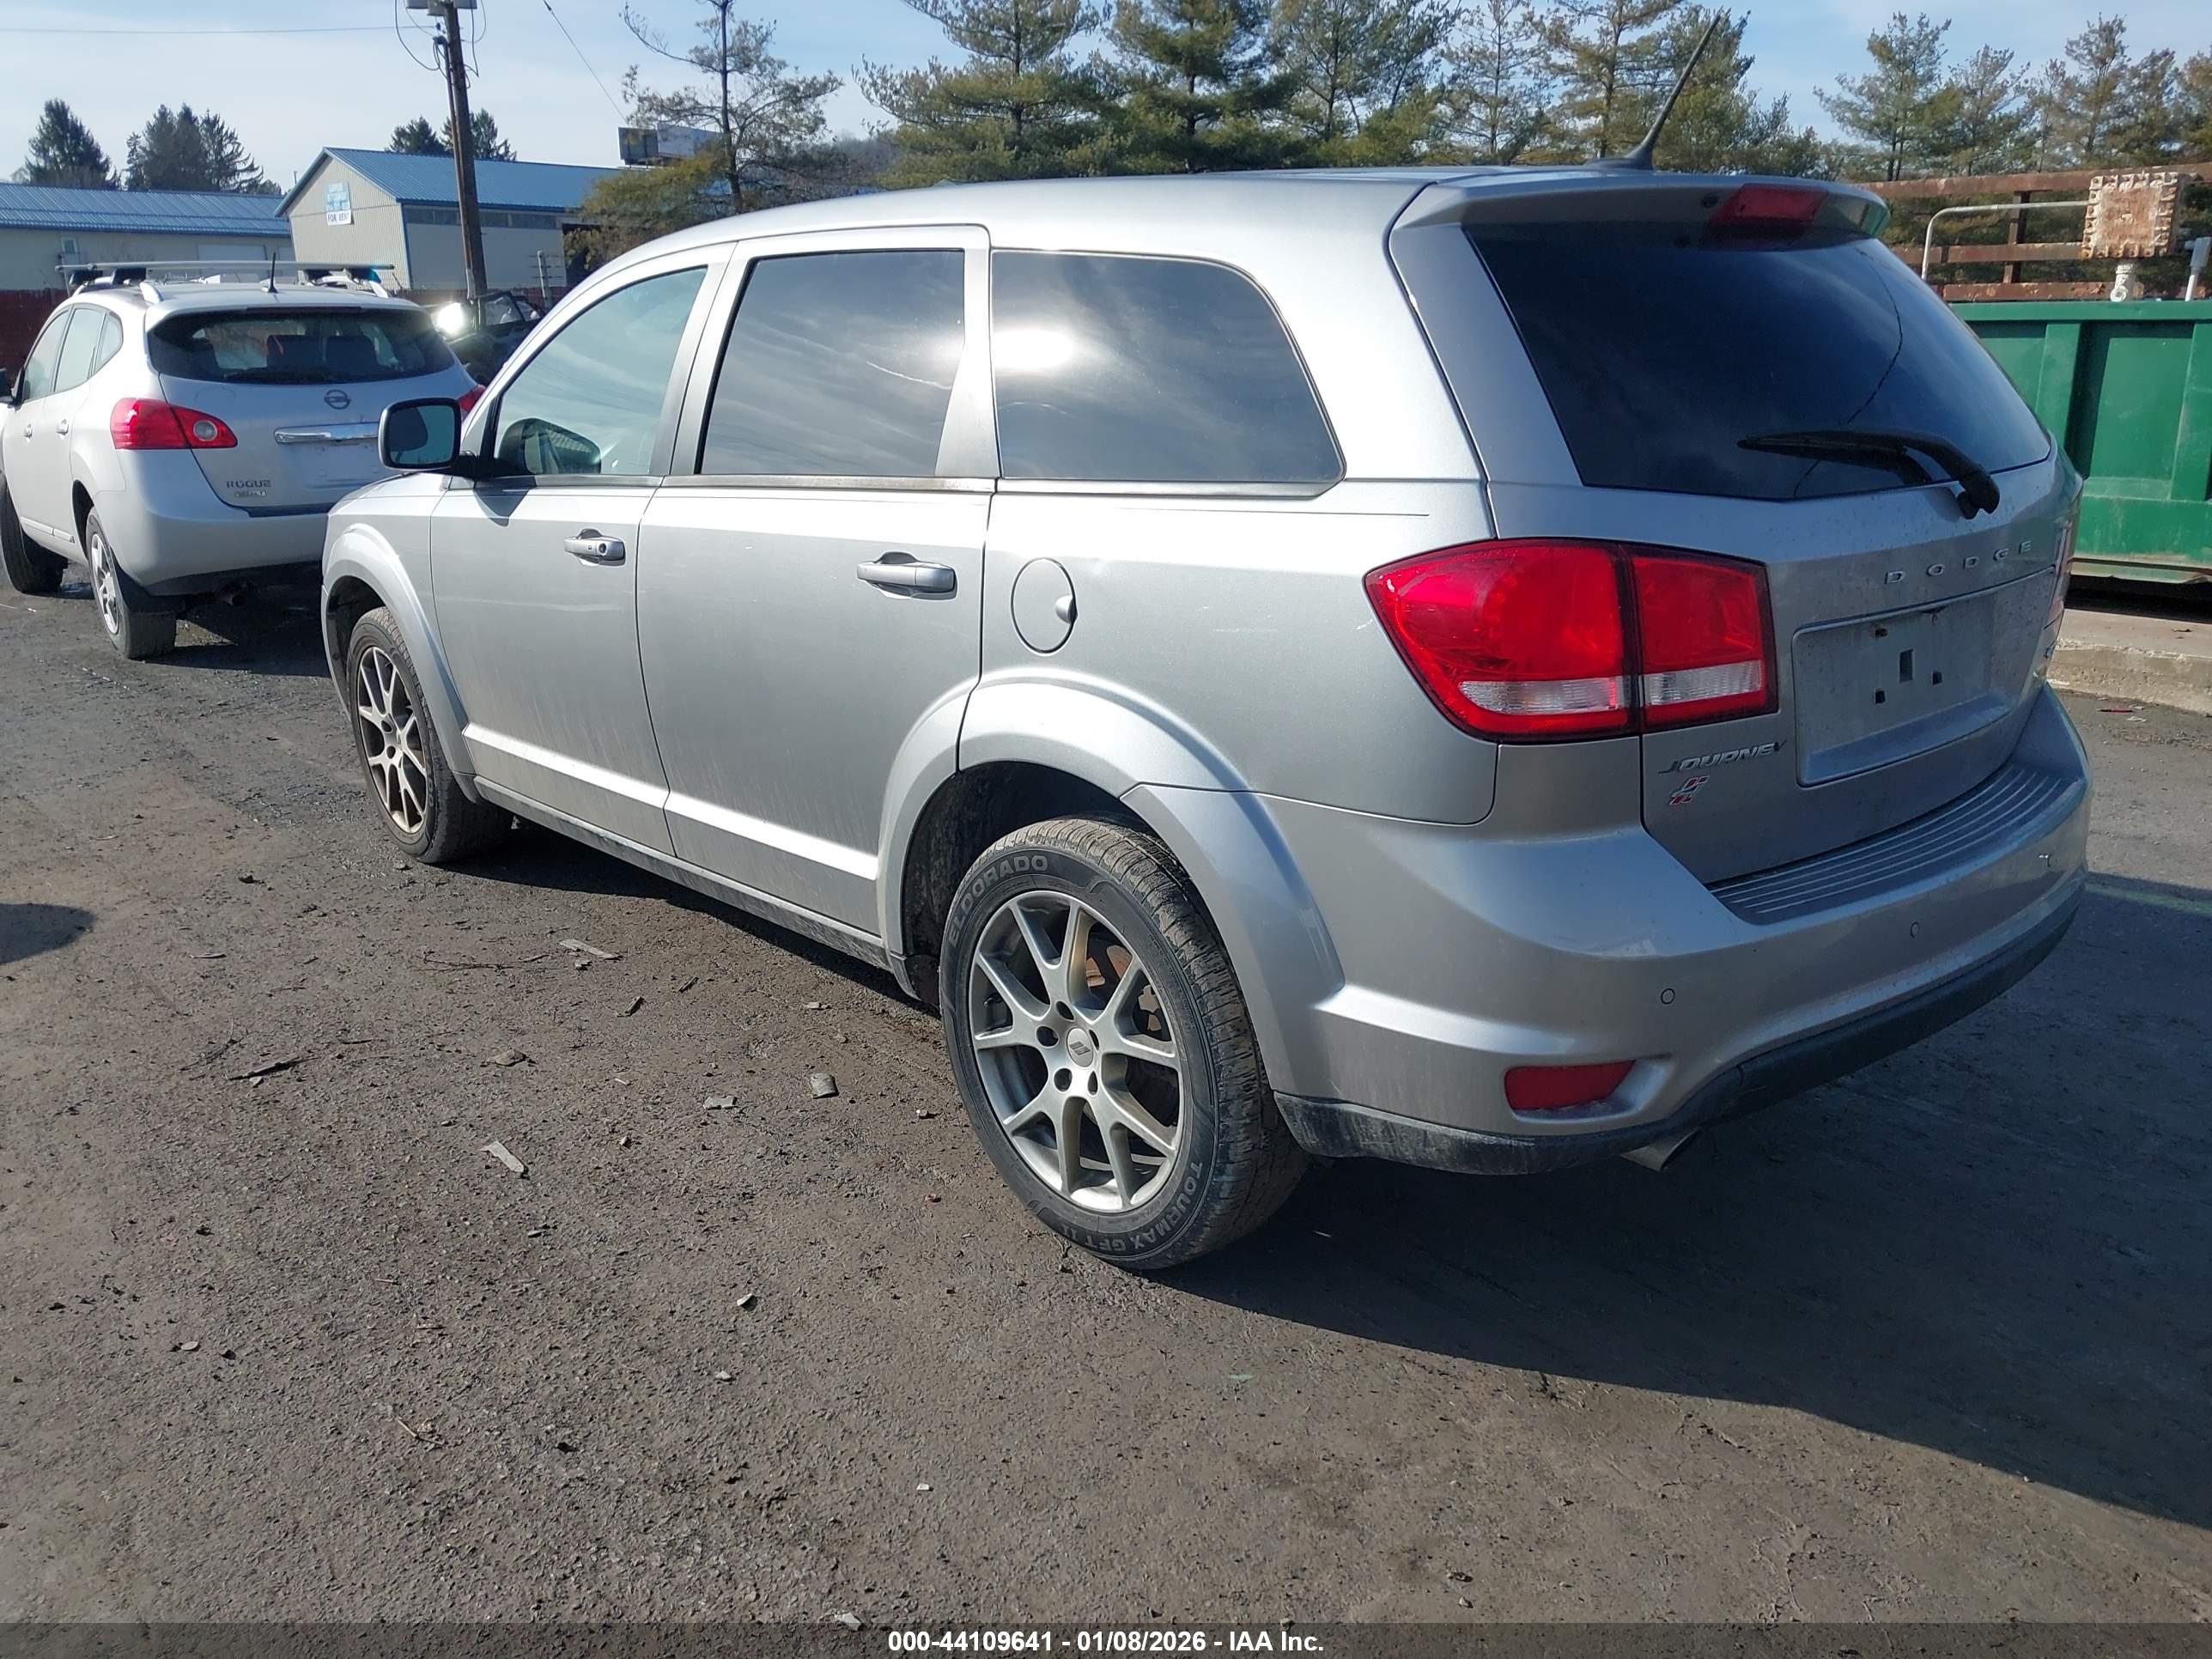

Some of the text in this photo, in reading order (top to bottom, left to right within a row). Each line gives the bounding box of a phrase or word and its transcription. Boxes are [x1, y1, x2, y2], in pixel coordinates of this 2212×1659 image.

[227, 480, 272, 489] ROGUE
[1885, 540, 2032, 584] DODGE
[1658, 740, 1786, 775] JOURNEY
[948, 854, 1048, 949] ELDORADO
[1129, 1161, 1203, 1250] TOURMAX
